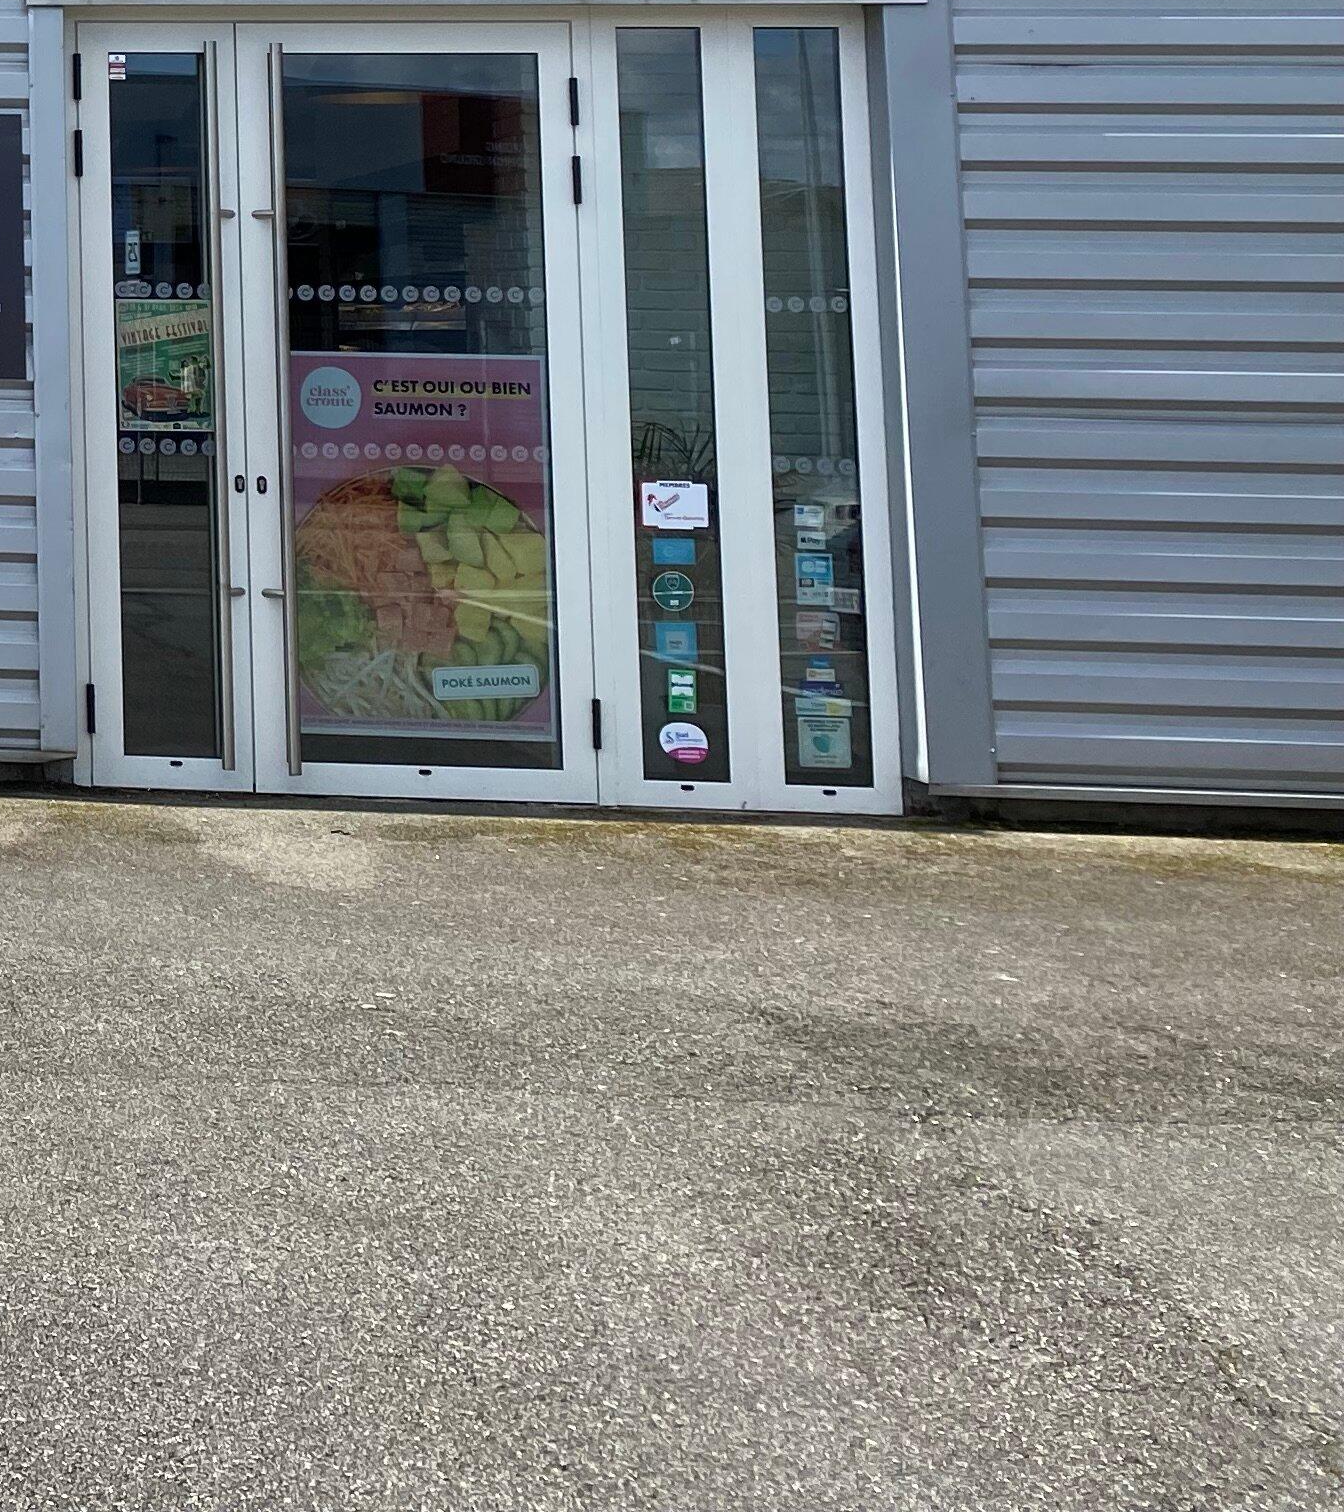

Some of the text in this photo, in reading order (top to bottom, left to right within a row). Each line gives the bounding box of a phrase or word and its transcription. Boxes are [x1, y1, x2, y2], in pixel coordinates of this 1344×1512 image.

[121, 319, 208, 345] VINTAGE FESTIVAL
[309, 384, 351, 397] class'
[373, 379, 531, 396] C'EST OUI OU BIEN
[306, 397, 354, 408] croute
[374, 401, 467, 417] SAUMON ?
[441, 675, 531, 689] POKÉ SAUMON
